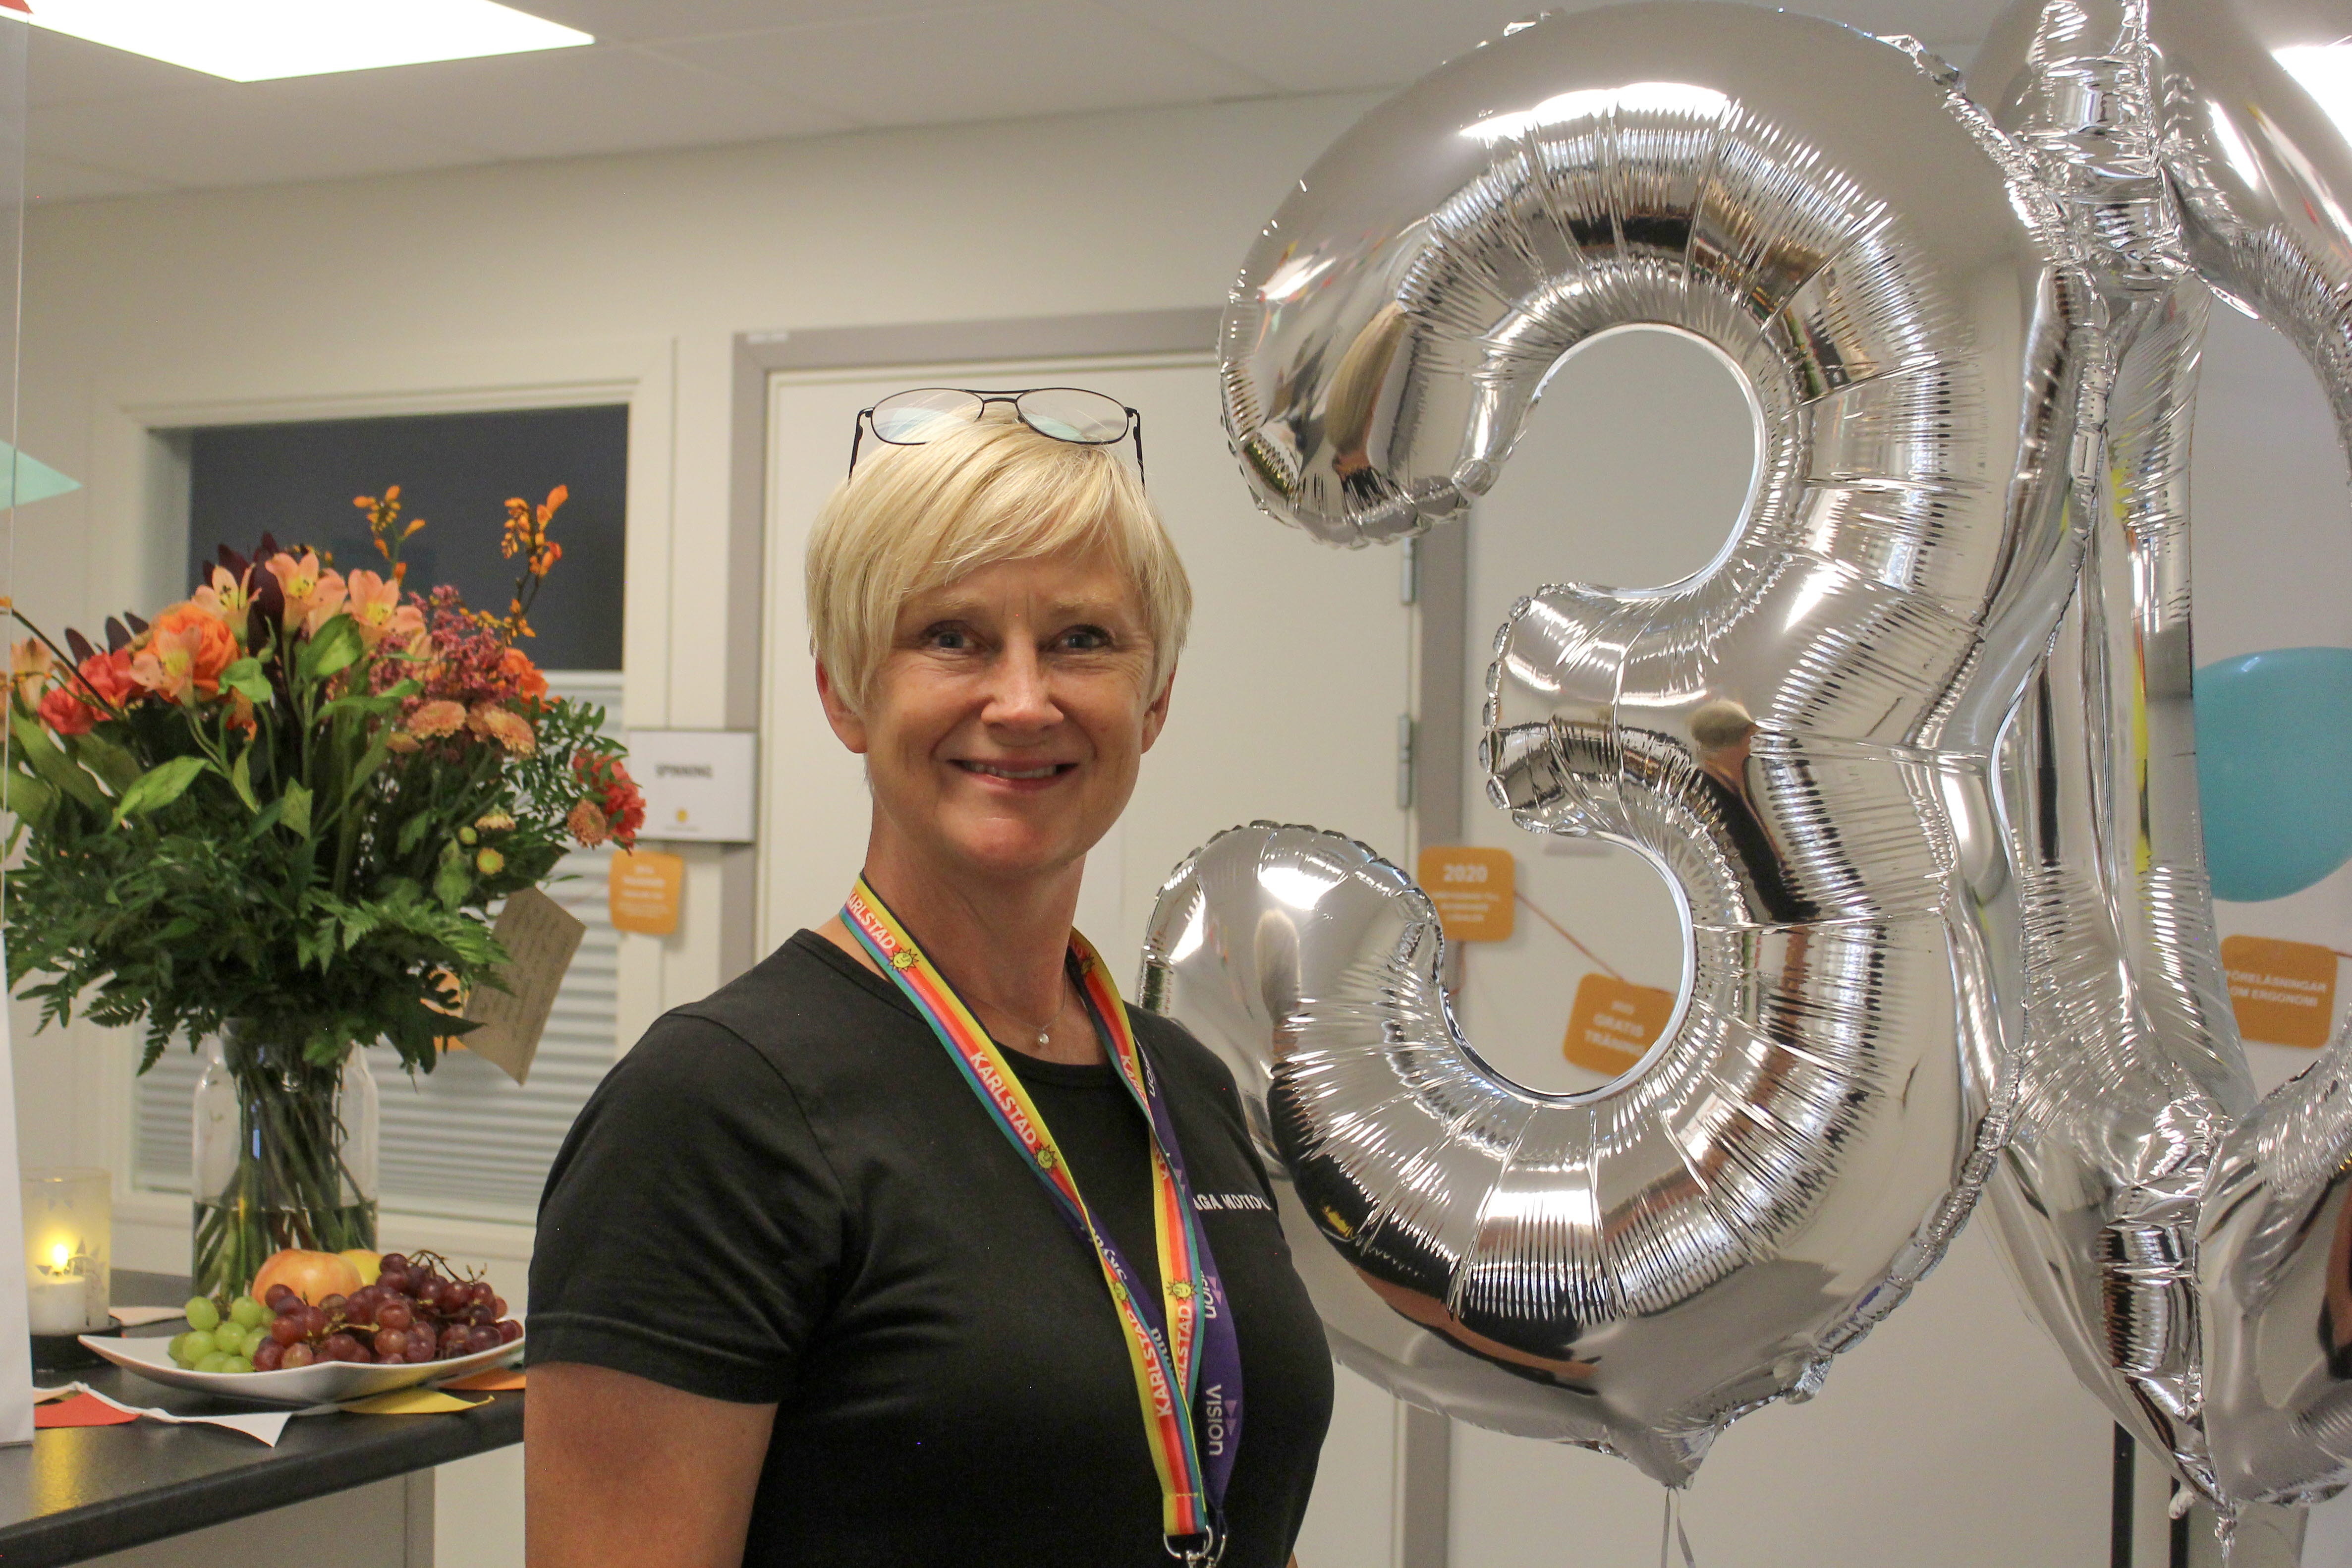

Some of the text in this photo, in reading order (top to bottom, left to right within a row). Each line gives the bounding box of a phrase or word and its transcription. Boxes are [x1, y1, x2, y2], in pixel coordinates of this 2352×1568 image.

[1444, 864, 1488, 883] 2020
[970, 1051, 1037, 1145] KARLSTAD
[1125, 1309, 1173, 1417] KARLSTAD
